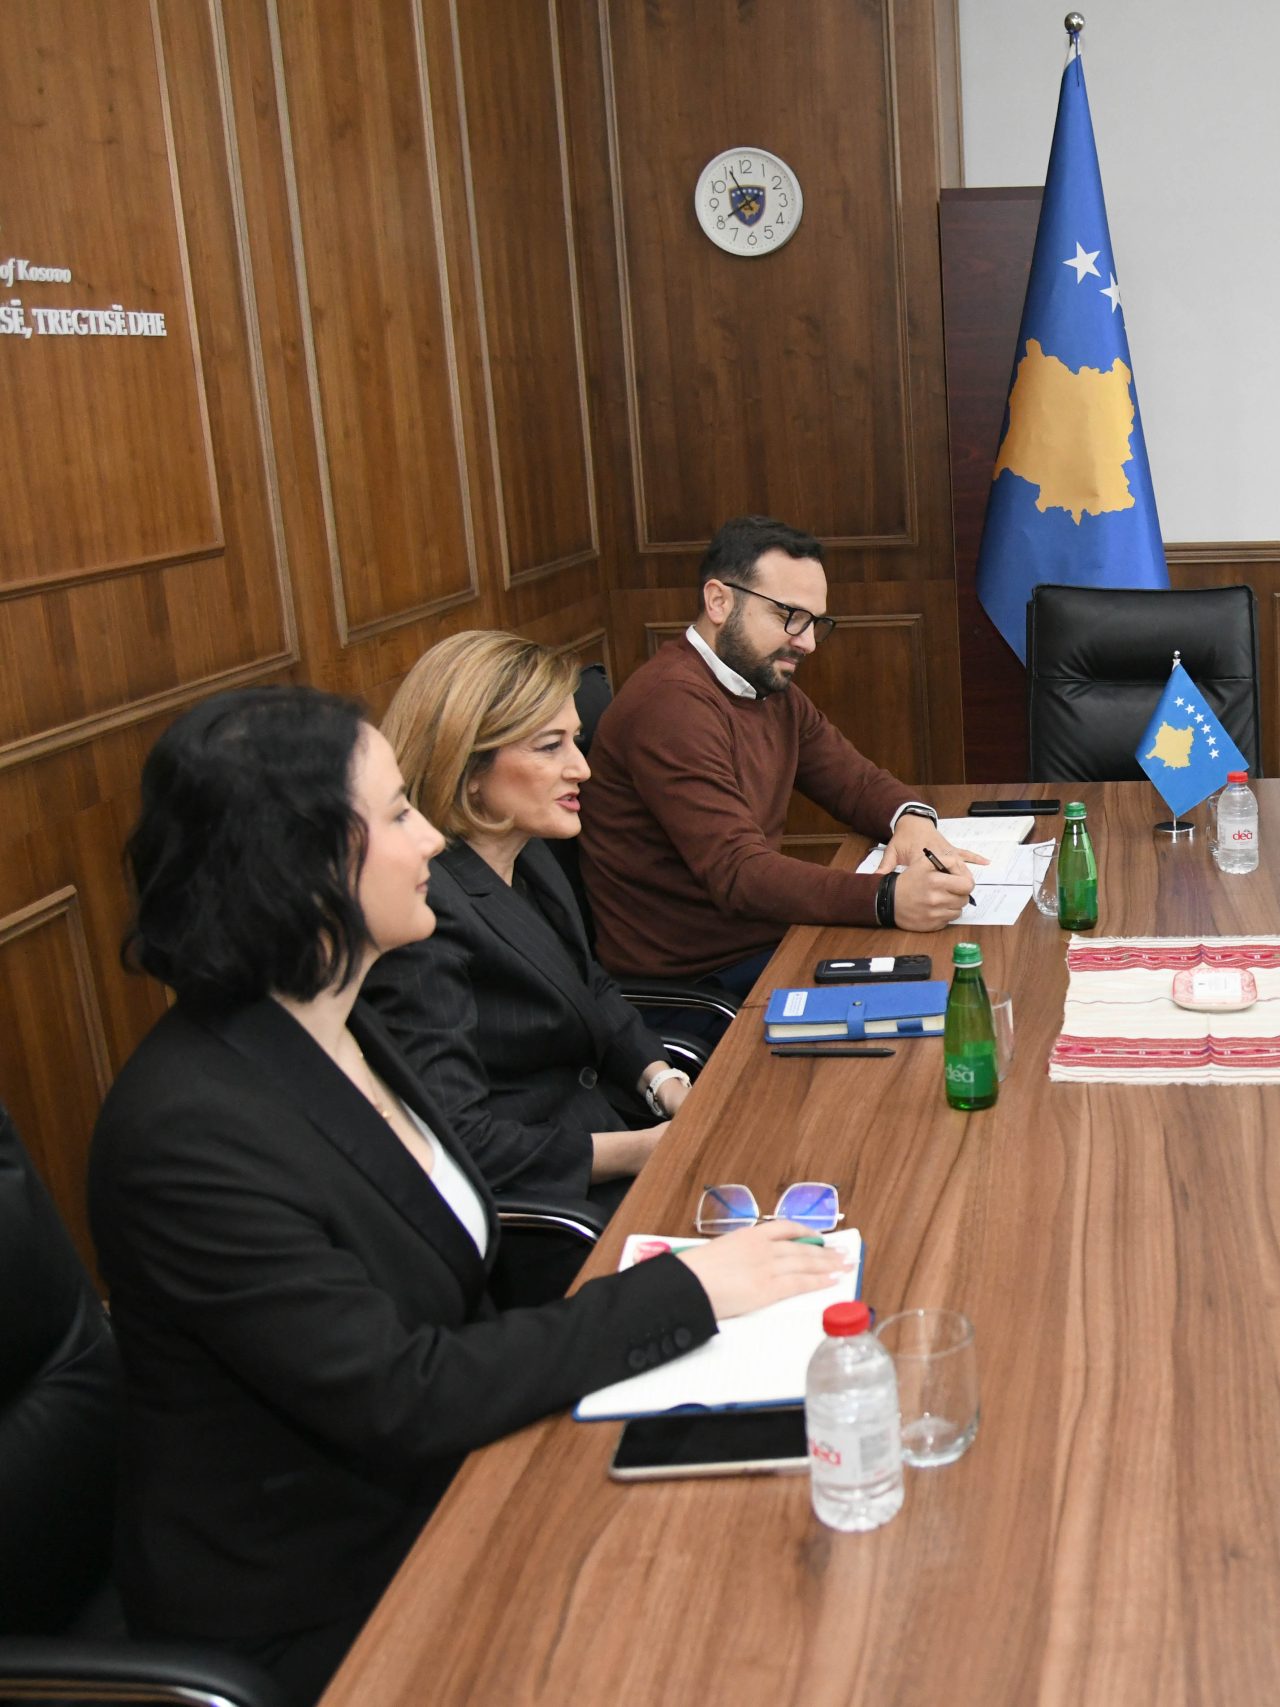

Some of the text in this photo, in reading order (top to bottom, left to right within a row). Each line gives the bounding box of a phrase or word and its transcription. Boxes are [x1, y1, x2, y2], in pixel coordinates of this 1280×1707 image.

[739, 160, 752, 173] 12
[761, 163, 766, 177] 1
[711, 180, 726, 194] 10
[771, 175, 781, 189] 2
[709, 198, 719, 212] 9
[779, 193, 788, 208] 3
[716, 216, 725, 230] 8
[776, 212, 784, 224] 4
[729, 228, 739, 241] 7
[747, 231, 757, 245] 6
[764, 226, 774, 239] 5
[0, 258, 72, 287] of Kosovo
[32, 304, 128, 335] TREGTISË
[127, 312, 167, 336] DHE
